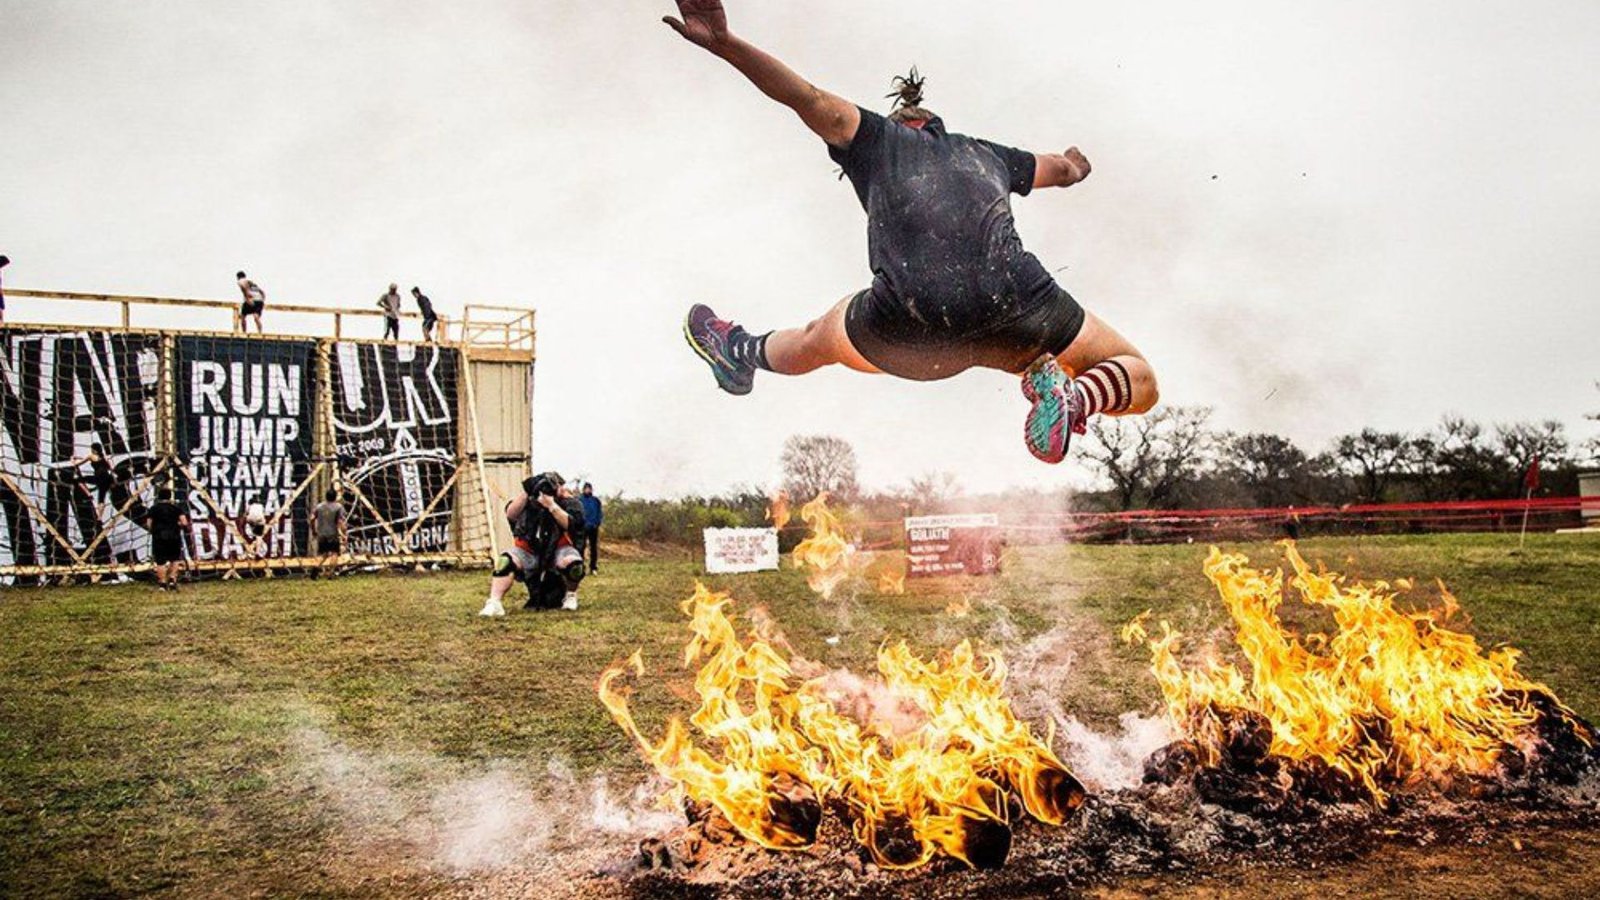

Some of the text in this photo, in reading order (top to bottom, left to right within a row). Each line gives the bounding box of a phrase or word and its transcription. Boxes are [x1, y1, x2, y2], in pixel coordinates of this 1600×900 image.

[191, 360, 300, 416] RUN
[189, 416, 300, 456] JUMP
[358, 438, 385, 453] 2009
[189, 456, 297, 488] CRAWL
[188, 489, 295, 519] SWEAT
[193, 520, 292, 560] DASH
